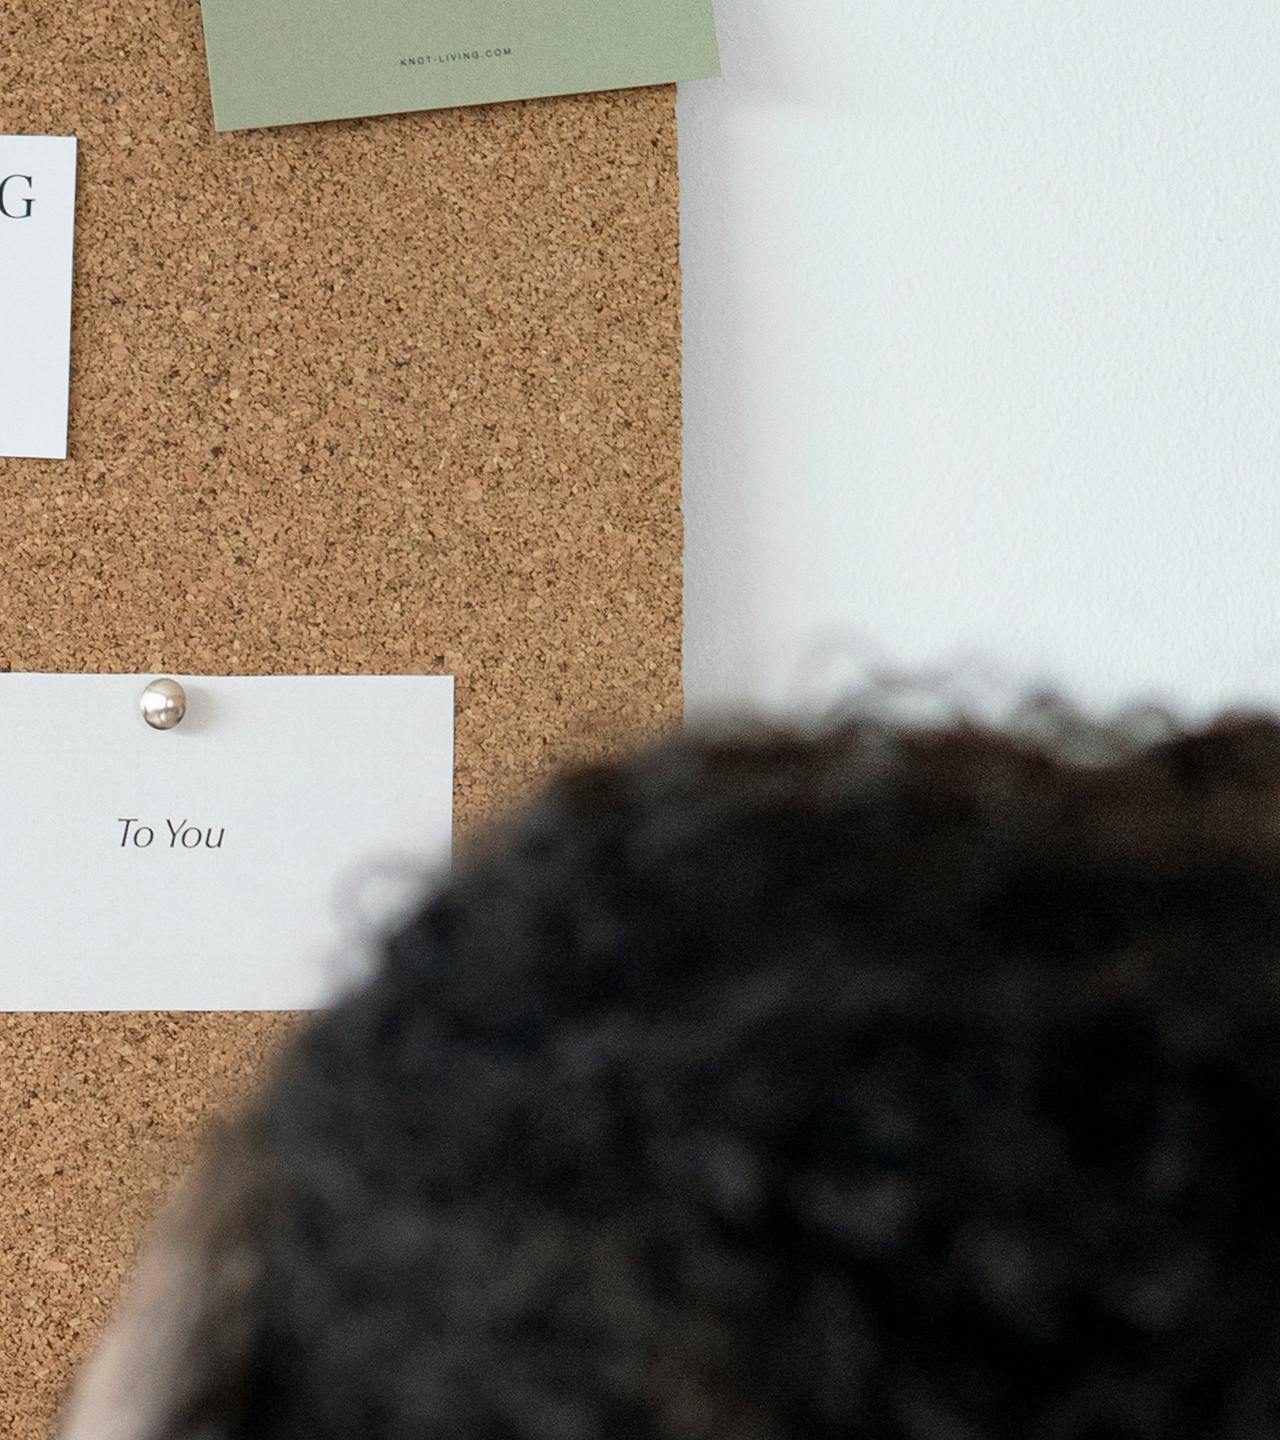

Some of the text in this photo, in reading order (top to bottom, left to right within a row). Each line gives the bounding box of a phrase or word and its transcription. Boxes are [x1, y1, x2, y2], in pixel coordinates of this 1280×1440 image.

[399, 47, 513, 67] KNOT-LIVING.COM
[117, 818, 226, 849] To You
